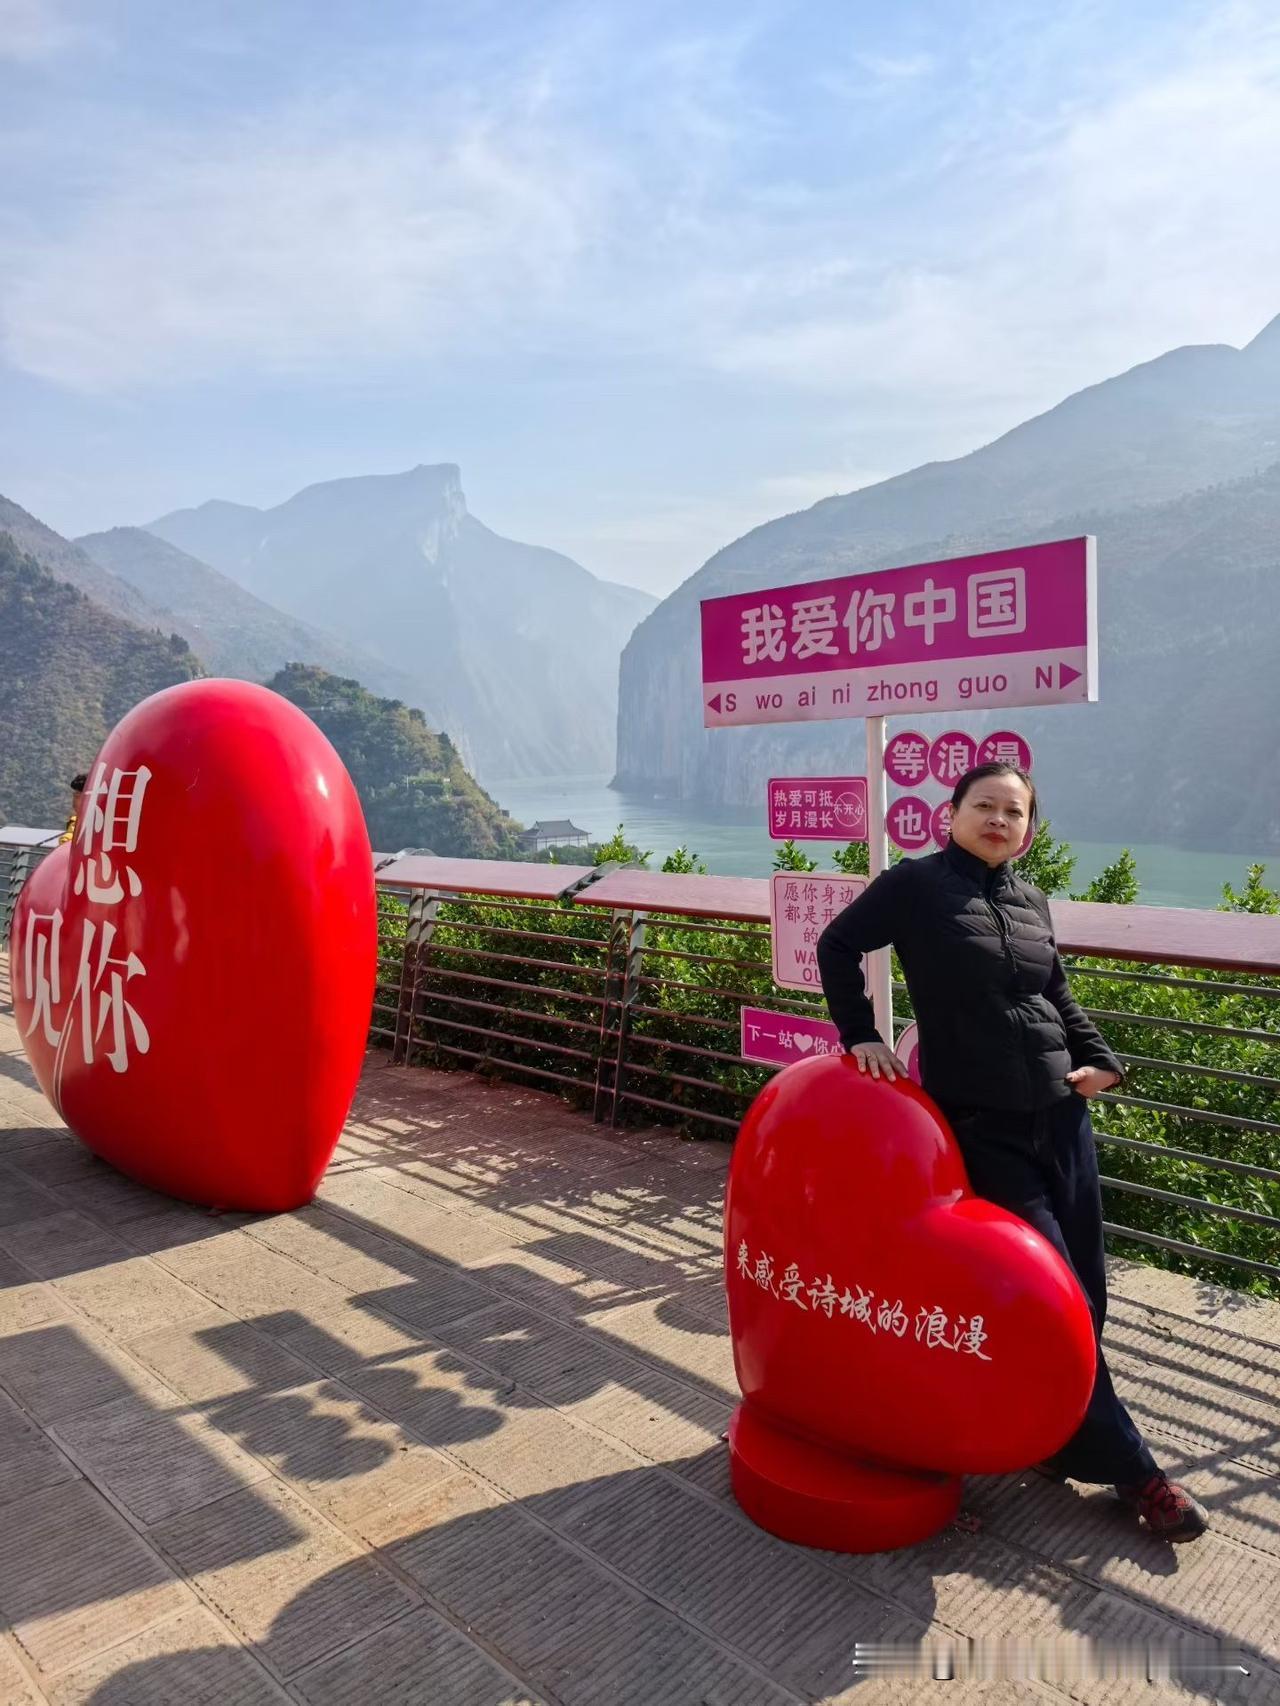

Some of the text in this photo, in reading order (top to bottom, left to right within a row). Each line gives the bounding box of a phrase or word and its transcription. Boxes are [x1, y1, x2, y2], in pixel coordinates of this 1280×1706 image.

[741, 567, 1027, 665] 我爱你中国
[725, 664, 1052, 712] S wo ai ni zhong guo N
[774, 790, 834, 807] 热爱可抵
[775, 811, 834, 828] 岁月漫长
[833, 803, 864, 816] 不开心
[784, 882, 854, 905] 愿你身边
